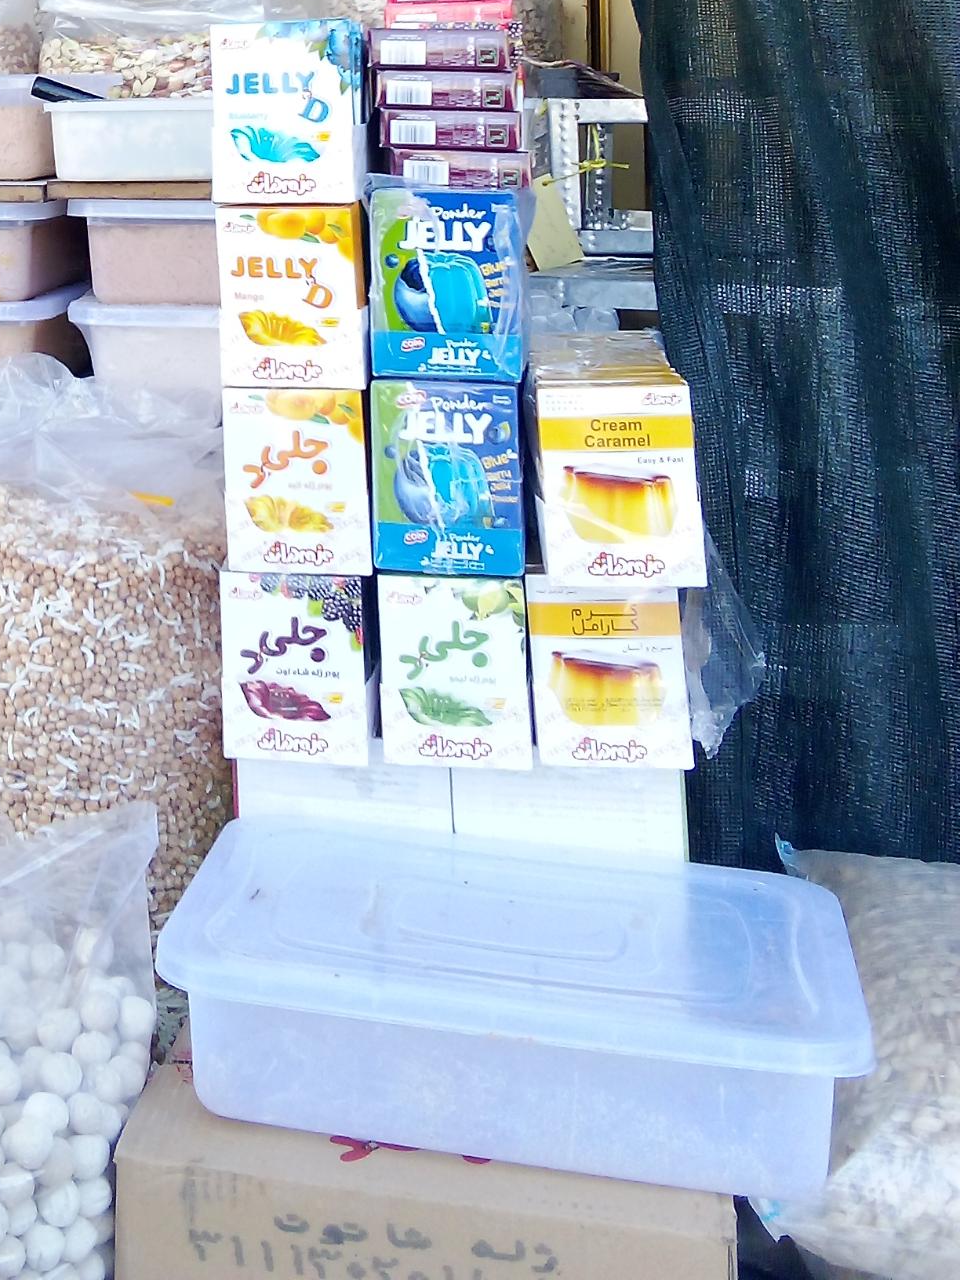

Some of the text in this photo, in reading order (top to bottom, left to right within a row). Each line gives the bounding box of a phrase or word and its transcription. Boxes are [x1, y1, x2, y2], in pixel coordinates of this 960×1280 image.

[225, 71, 315, 95] JELLY
[399, 219, 492, 251] JELLY
[231, 256, 318, 279] JELLY
[398, 411, 493, 444] JELLY
[590, 419, 642, 431] Cream
[584, 434, 651, 448] Caramel
[572, 619, 639, 636] کارامل
